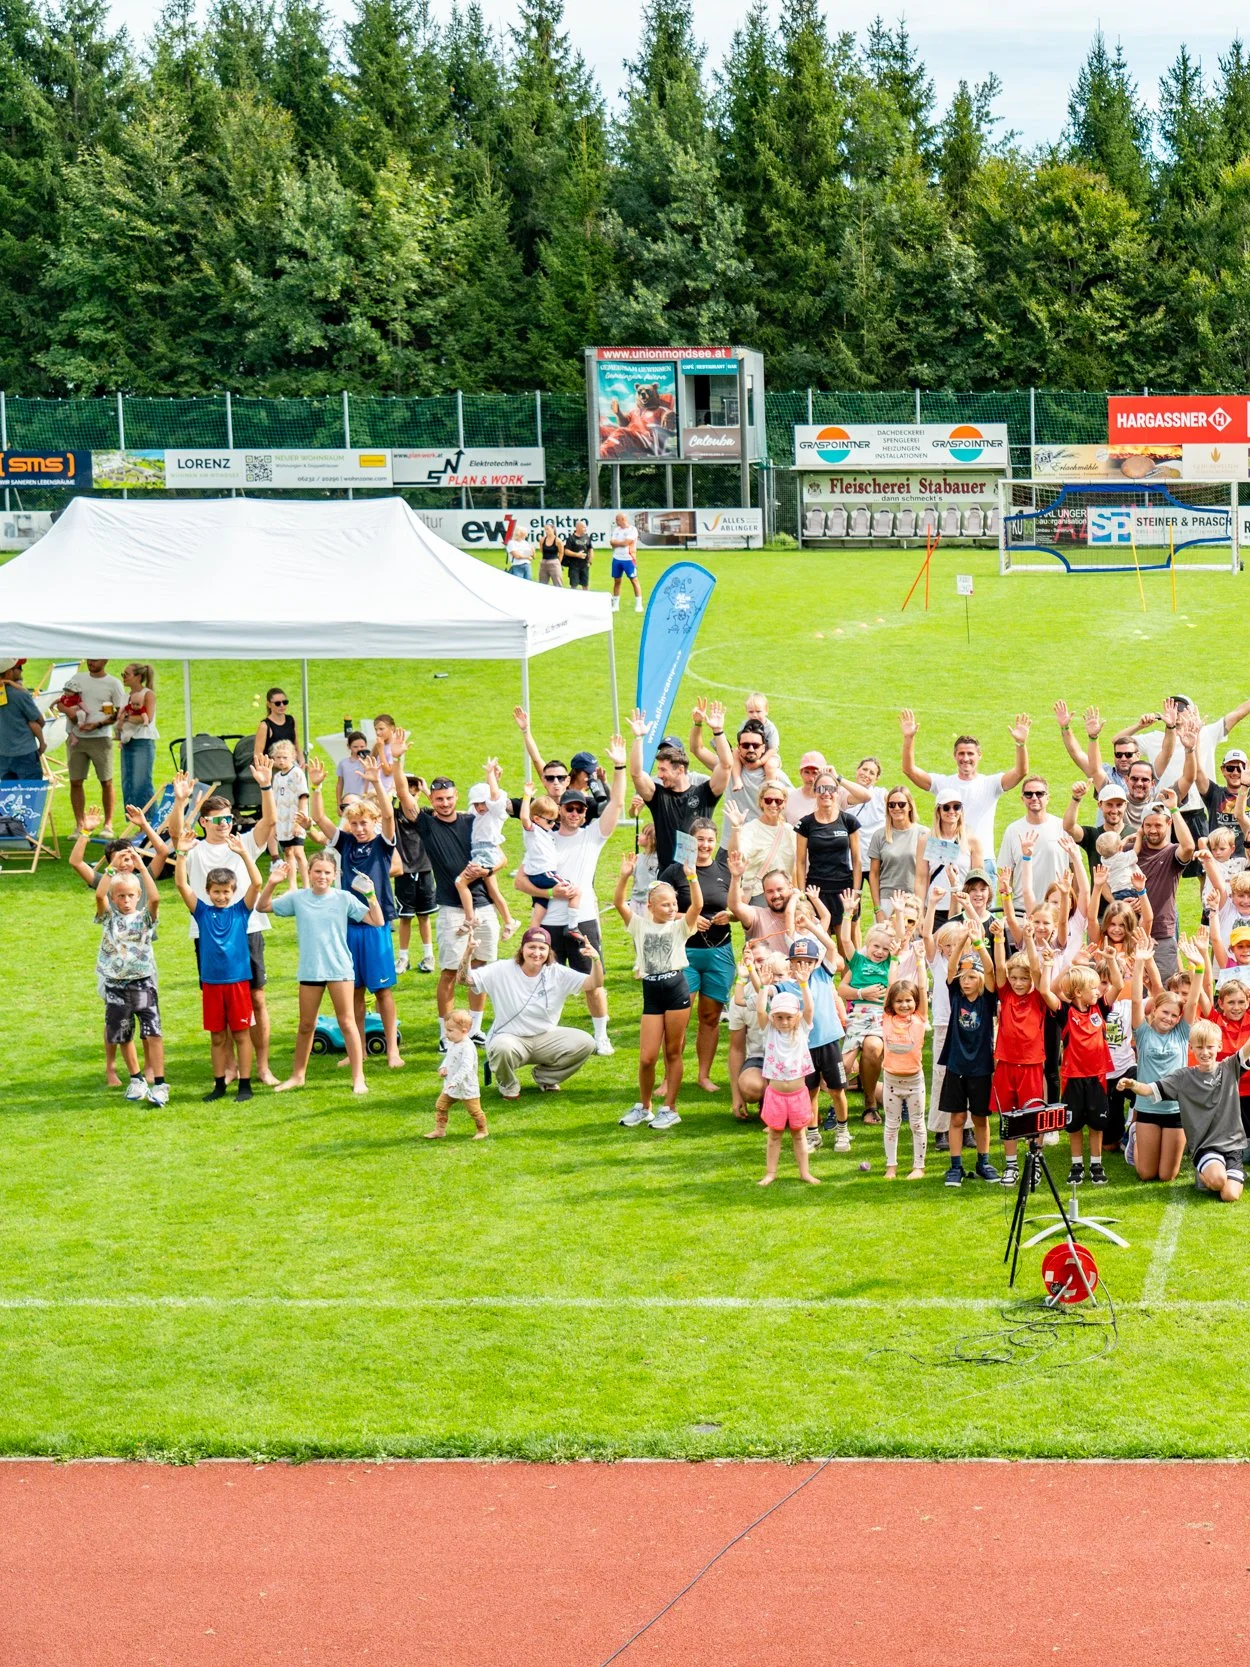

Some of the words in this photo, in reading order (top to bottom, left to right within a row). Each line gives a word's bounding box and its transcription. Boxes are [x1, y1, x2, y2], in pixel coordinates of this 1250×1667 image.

[604, 349, 726, 359] www.unionmondsee.at
[1117, 412, 1207, 428] HARGASSNER
[800, 441, 870, 449] GRASPOINTNER
[932, 440, 1003, 448] GRASPOINTNER
[8, 457, 63, 473] sms
[177, 458, 231, 469] LORENZ
[469, 459, 519, 467] Elektrotechnik
[448, 475, 478, 486] PLAN
[480, 475, 487, 485] &
[491, 475, 524, 485] WORK
[829, 477, 910, 495] Fleischerei
[919, 477, 986, 495] Stabauer
[1058, 509, 1087, 518] UNGER
[1136, 517, 1178, 527] STEINER
[1181, 517, 1189, 526] &
[1192, 517, 1232, 527] PRASCH
[658, 970, 678, 981] PRO
